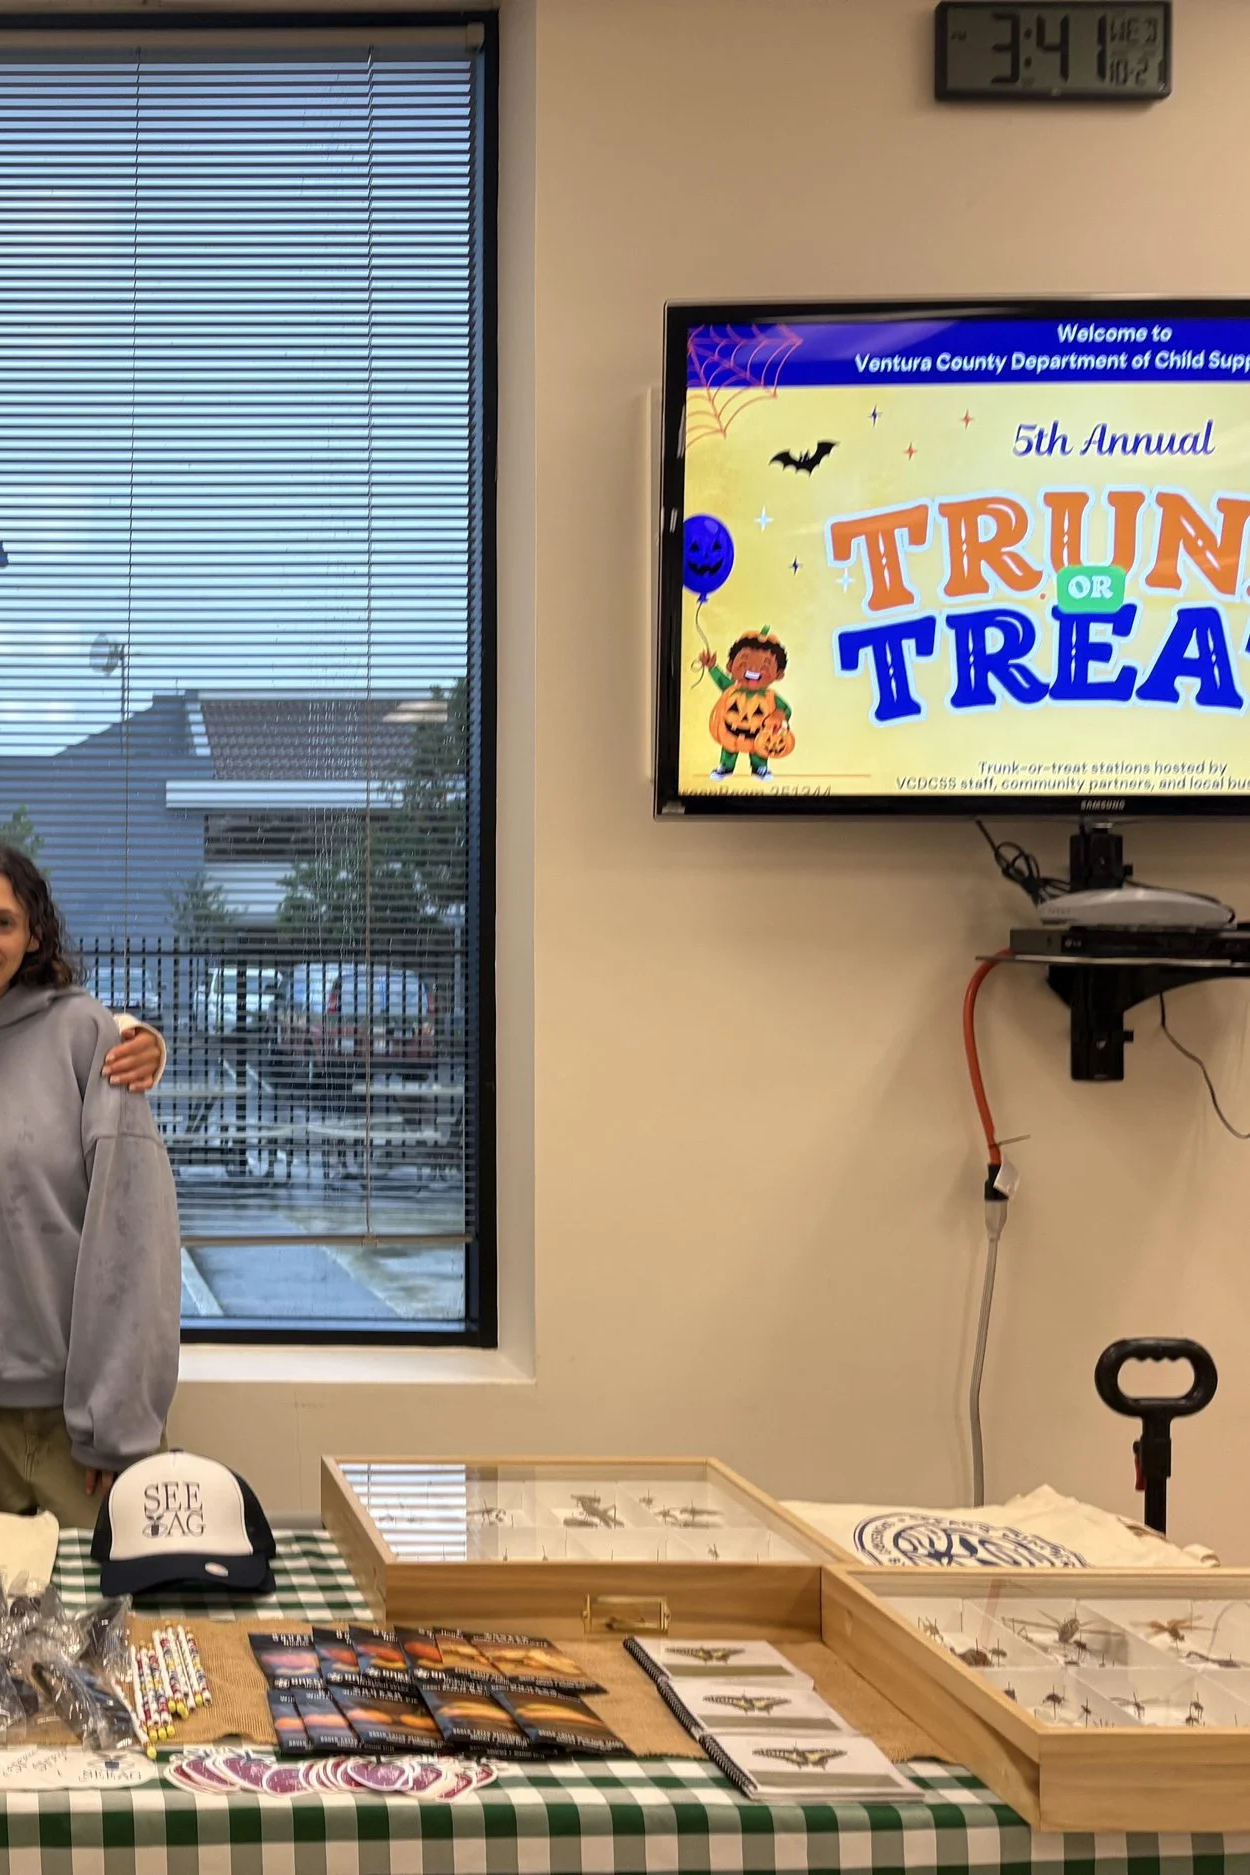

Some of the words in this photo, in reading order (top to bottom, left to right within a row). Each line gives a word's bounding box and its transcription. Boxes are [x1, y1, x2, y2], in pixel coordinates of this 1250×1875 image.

[990, 14, 1107, 84] 3:41
[1057, 322, 1149, 344] Welcome
[1151, 324, 1173, 343] to
[854, 352, 932, 373] Ventura
[936, 351, 1008, 375] County
[1011, 351, 1129, 375] Department
[1131, 349, 1152, 370] of
[1154, 349, 1206, 370] Child
[1012, 420, 1074, 458] 5th
[1079, 418, 1216, 458] Annual
[830, 490, 1250, 611] TRUN
[1067, 572, 1115, 600] OR
[838, 604, 1250, 722] TREA
[979, 761, 1088, 775] Trunk-or-treat
[1091, 761, 1150, 775] stations
[1154, 760, 1205, 775] hosted
[1209, 760, 1228, 777] by
[896, 777, 957, 791] VCDCSS
[960, 776, 997, 792] staff,
[1001, 777, 1085, 794] community
[1088, 778, 1155, 794] partners,
[1159, 776, 1187, 790] and
[1190, 776, 1225, 790] local
[1081, 800, 1126, 811] SAMSUNG
[143, 1481, 203, 1515] SEE
[165, 1510, 206, 1538] AG
